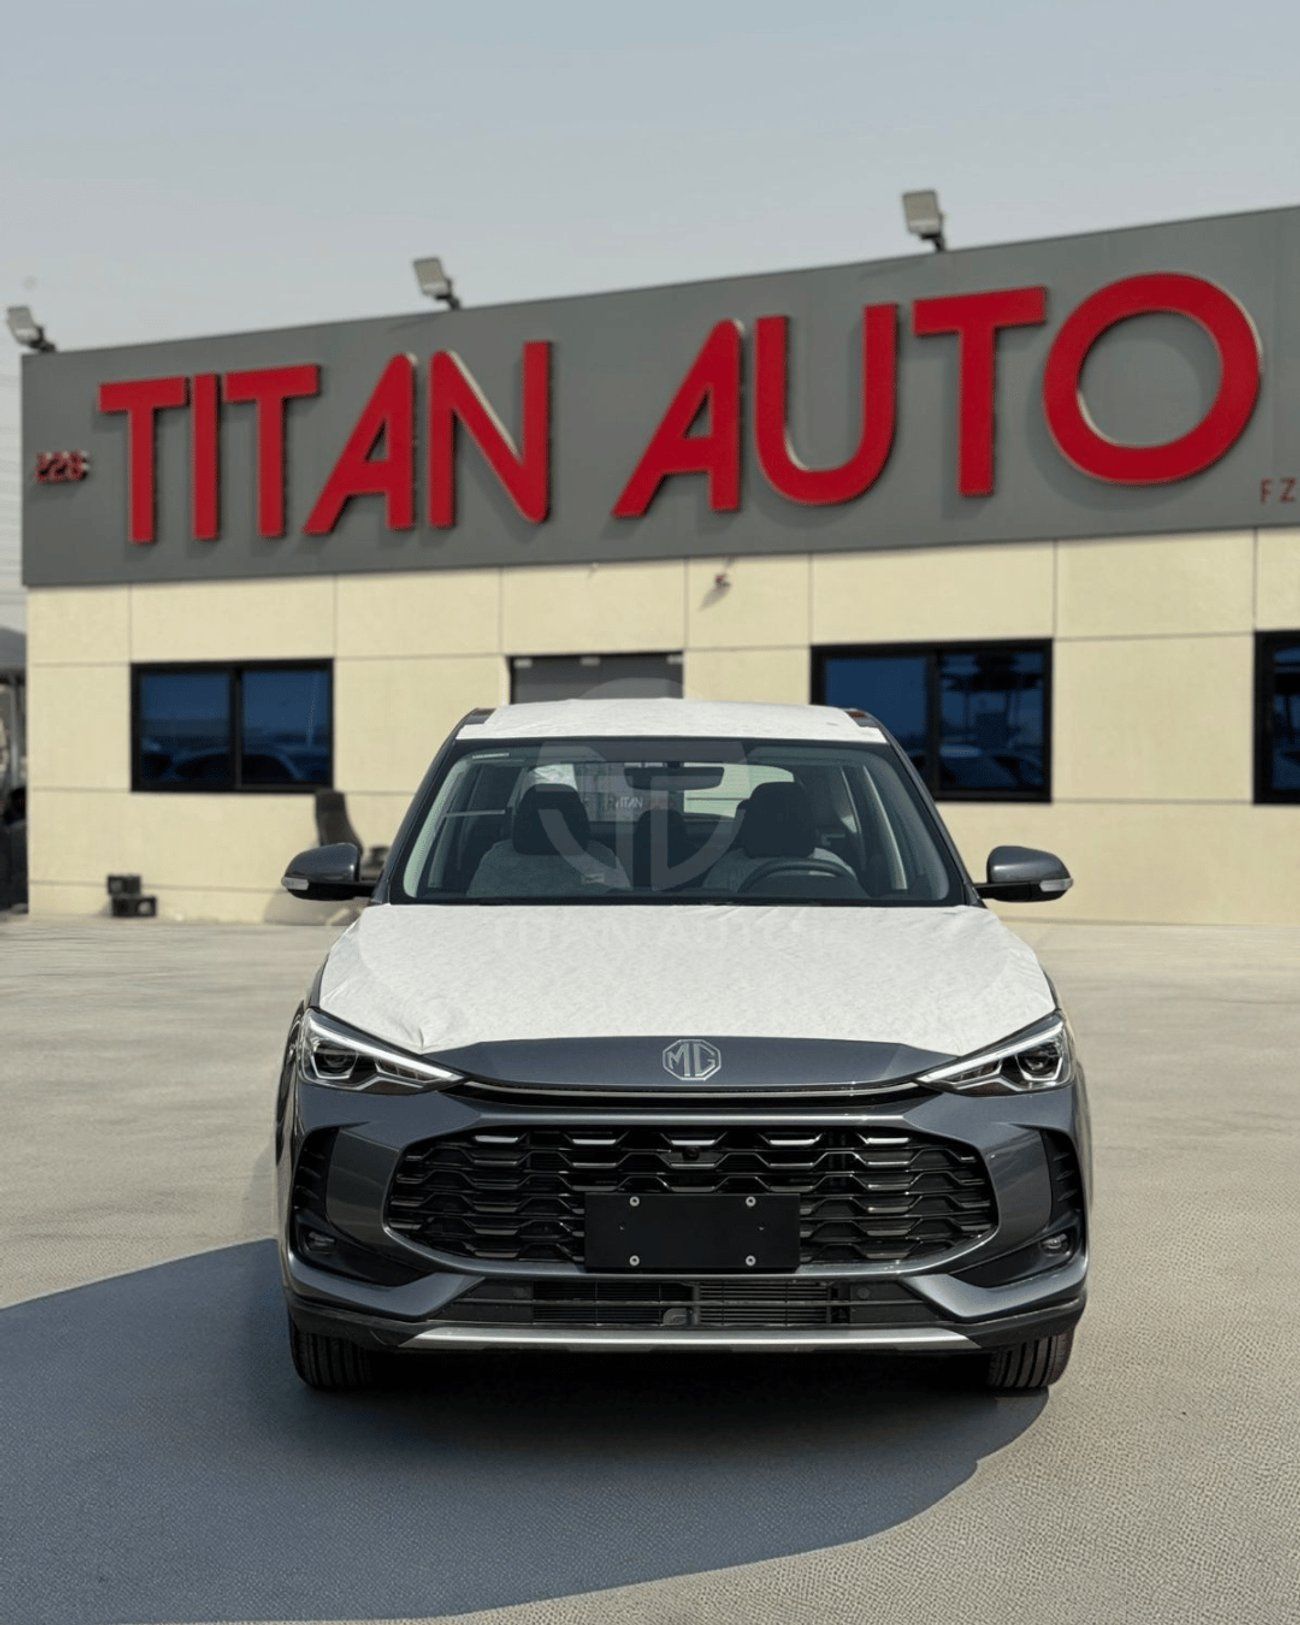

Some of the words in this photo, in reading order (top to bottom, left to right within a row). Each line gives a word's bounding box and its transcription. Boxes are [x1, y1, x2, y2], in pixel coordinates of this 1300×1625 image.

[98, 341, 550, 544] TITAN
[613, 272, 1262, 518] AUTO
[667, 1042, 716, 1077] MG
